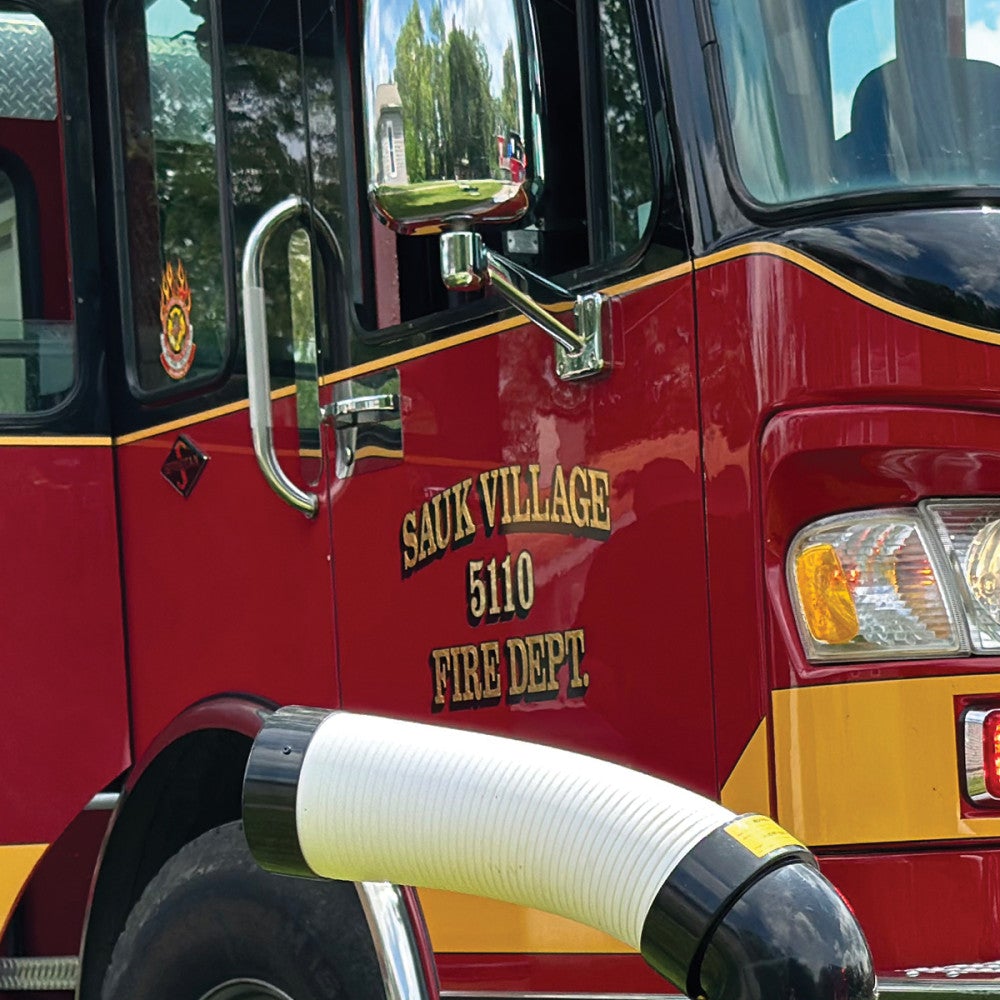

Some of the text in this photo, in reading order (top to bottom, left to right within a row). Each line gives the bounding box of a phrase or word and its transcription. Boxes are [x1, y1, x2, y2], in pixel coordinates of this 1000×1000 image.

[402, 464, 612, 572] SAUK VILLAGE
[468, 550, 535, 619] 5110
[431, 628, 590, 705] FIRE DEPT.
